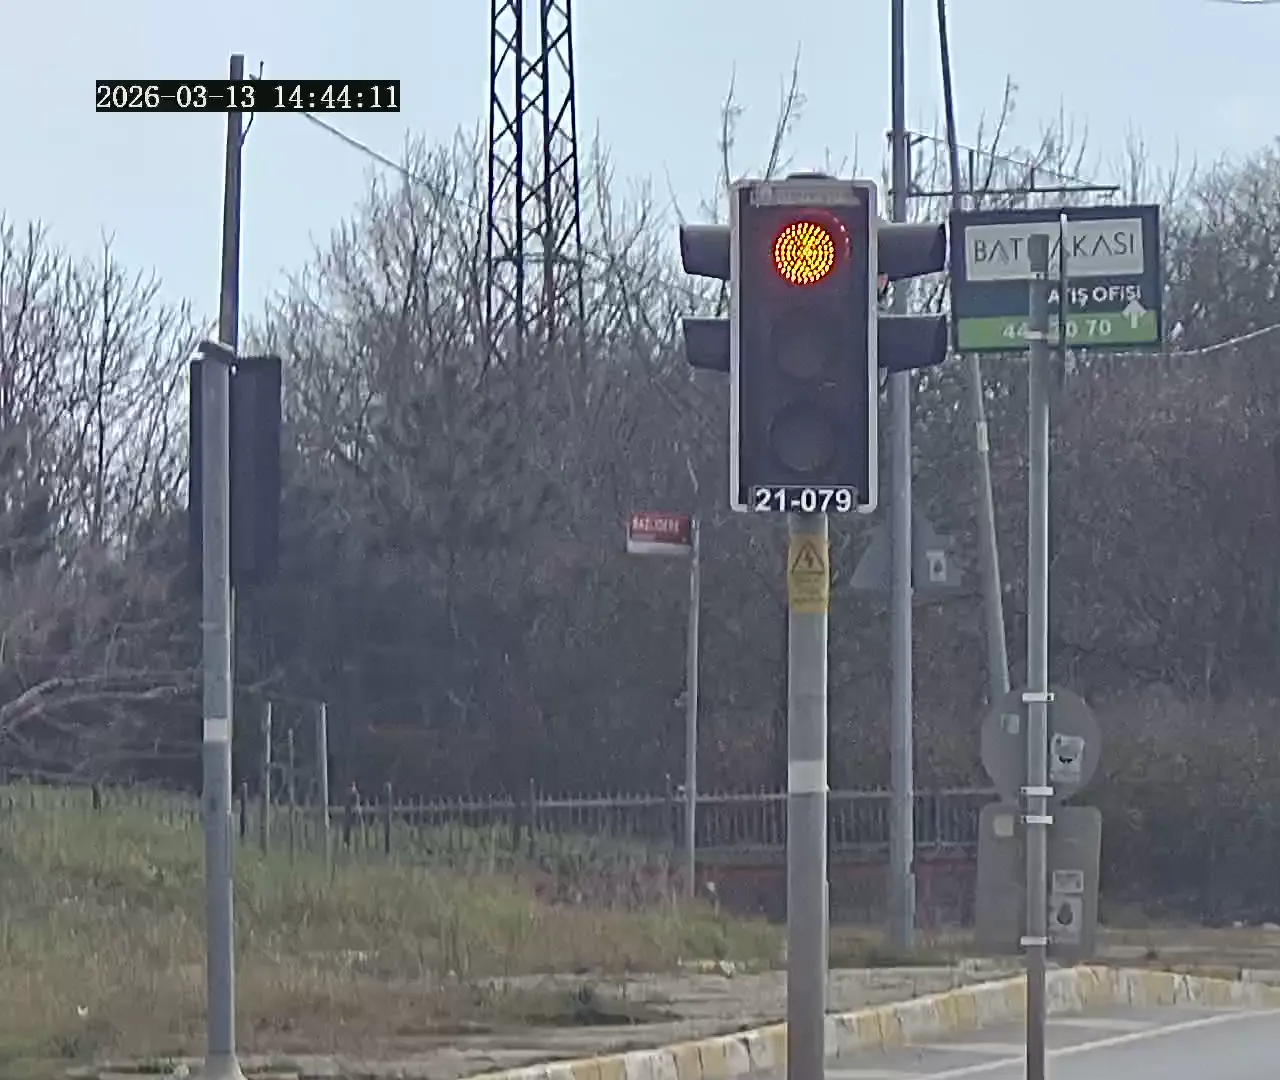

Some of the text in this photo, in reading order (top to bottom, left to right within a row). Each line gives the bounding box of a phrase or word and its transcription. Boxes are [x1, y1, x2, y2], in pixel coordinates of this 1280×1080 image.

[974, 236, 1030, 264] BAT
[1085, 319, 1112, 336] 70
[755, 488, 851, 512] 21-079
